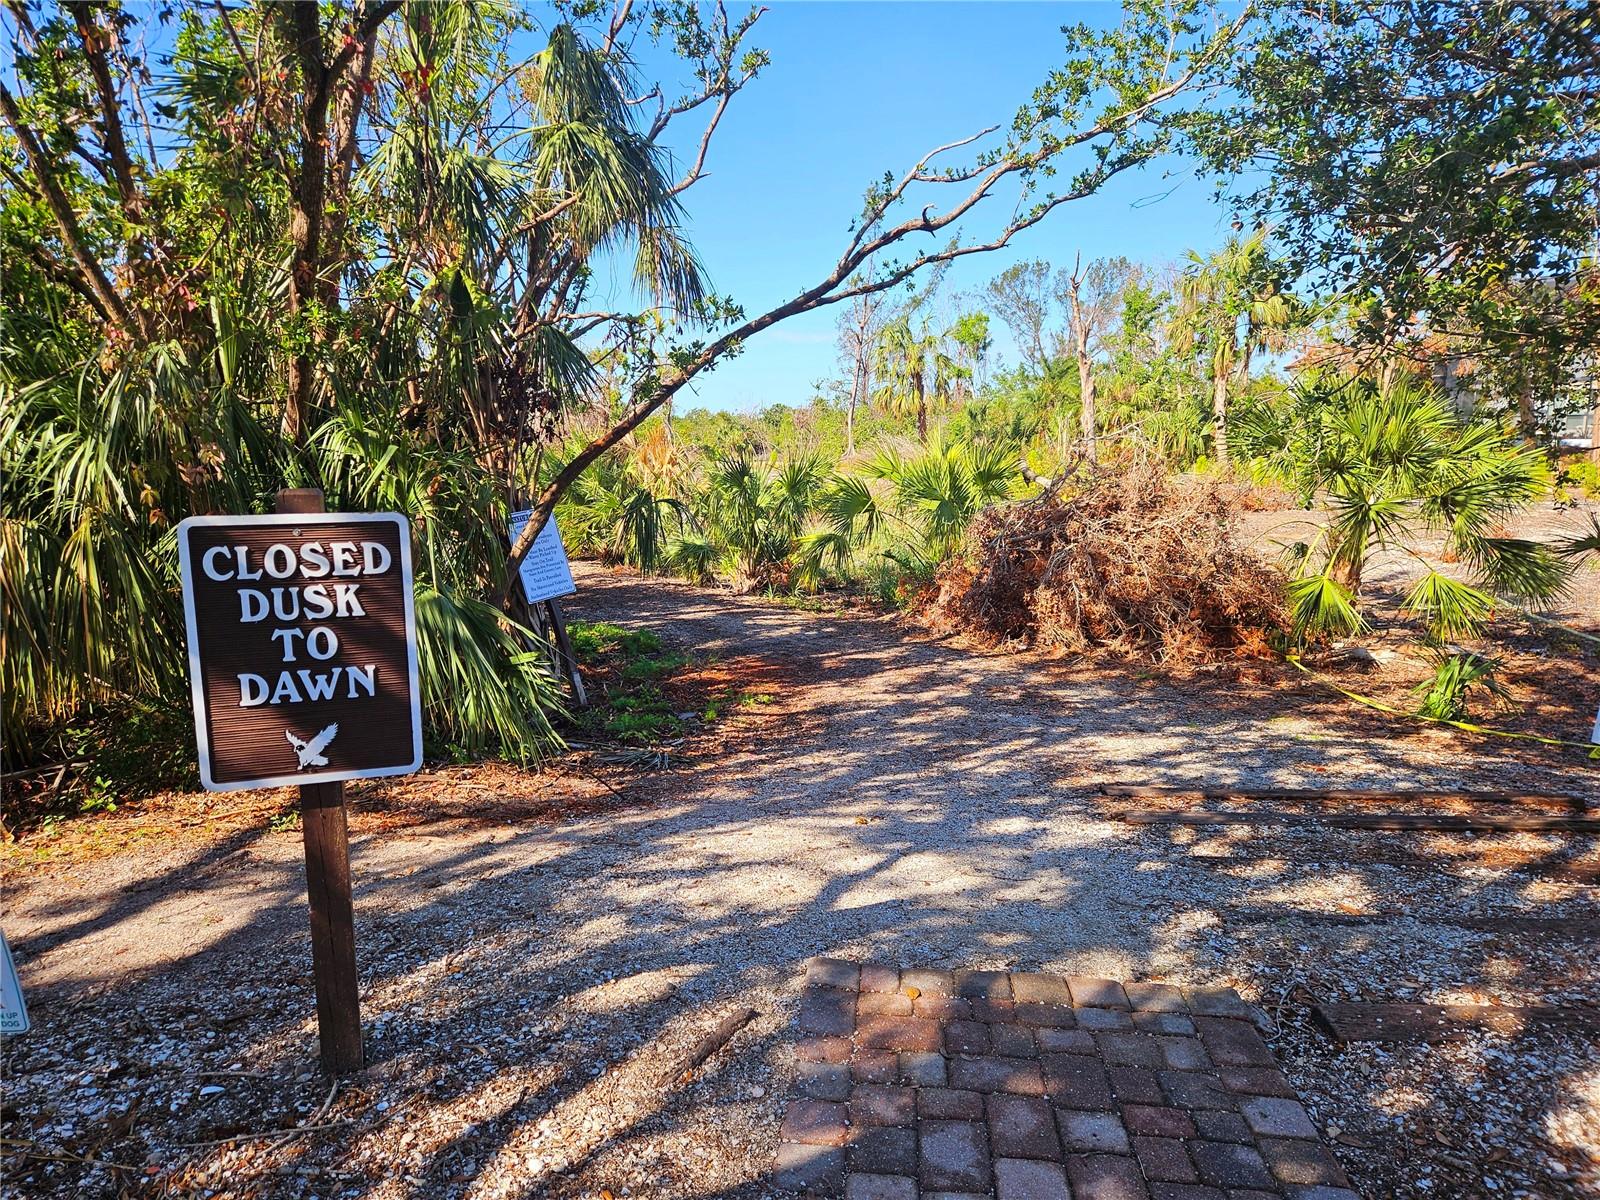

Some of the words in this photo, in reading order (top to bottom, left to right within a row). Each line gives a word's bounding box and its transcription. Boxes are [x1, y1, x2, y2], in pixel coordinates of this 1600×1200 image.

[202, 541, 392, 582] CLOSED
[237, 583, 366, 623] DUSK
[271, 626, 338, 662] TO
[237, 664, 376, 707] DAWN
